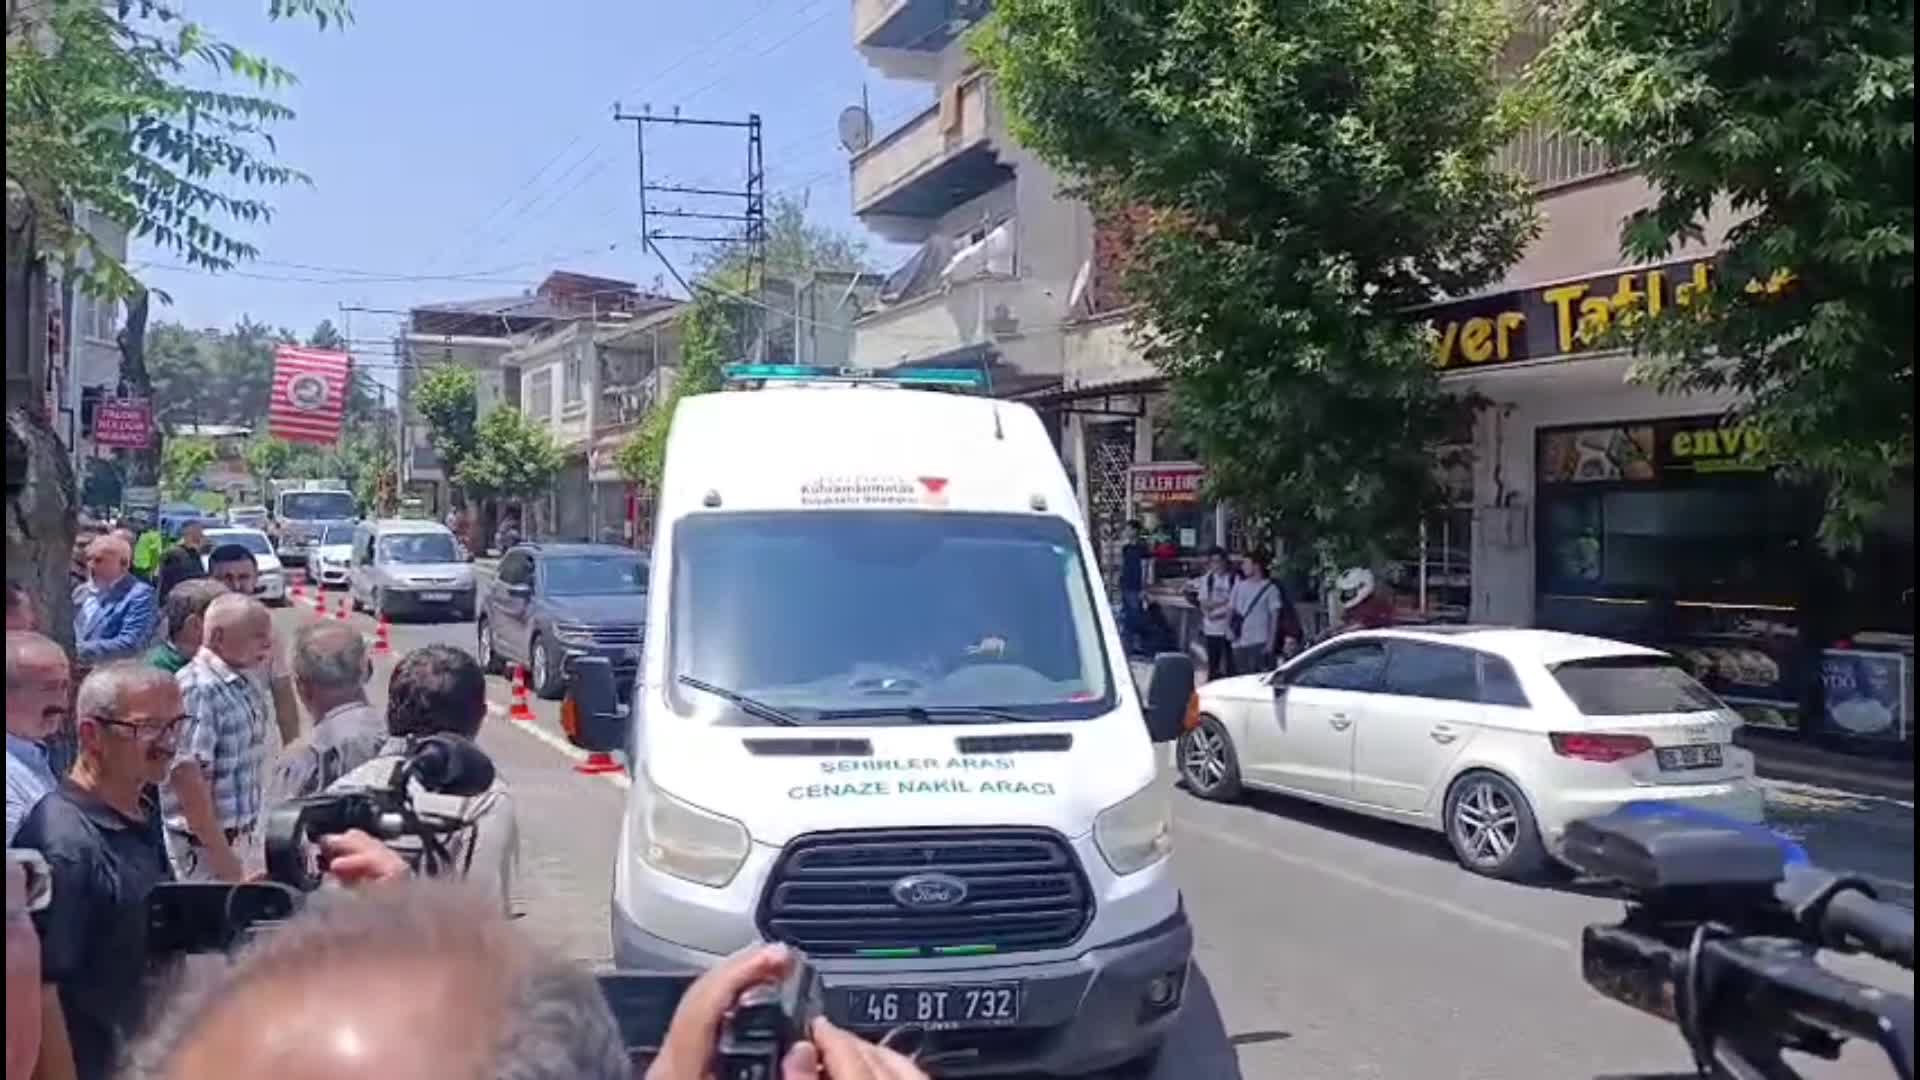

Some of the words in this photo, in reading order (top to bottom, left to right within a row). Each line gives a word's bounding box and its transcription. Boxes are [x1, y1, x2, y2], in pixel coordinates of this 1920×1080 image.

[946, 757, 1015, 770] ARASI
[787, 782, 891, 799] CENAZE
[898, 777, 972, 793] NAKİL
[980, 780, 1057, 795] ARACI
[911, 883, 952, 902] Ford
[867, 994, 898, 1021] 46
[917, 991, 948, 1020] BT
[965, 989, 1011, 1018] 732
